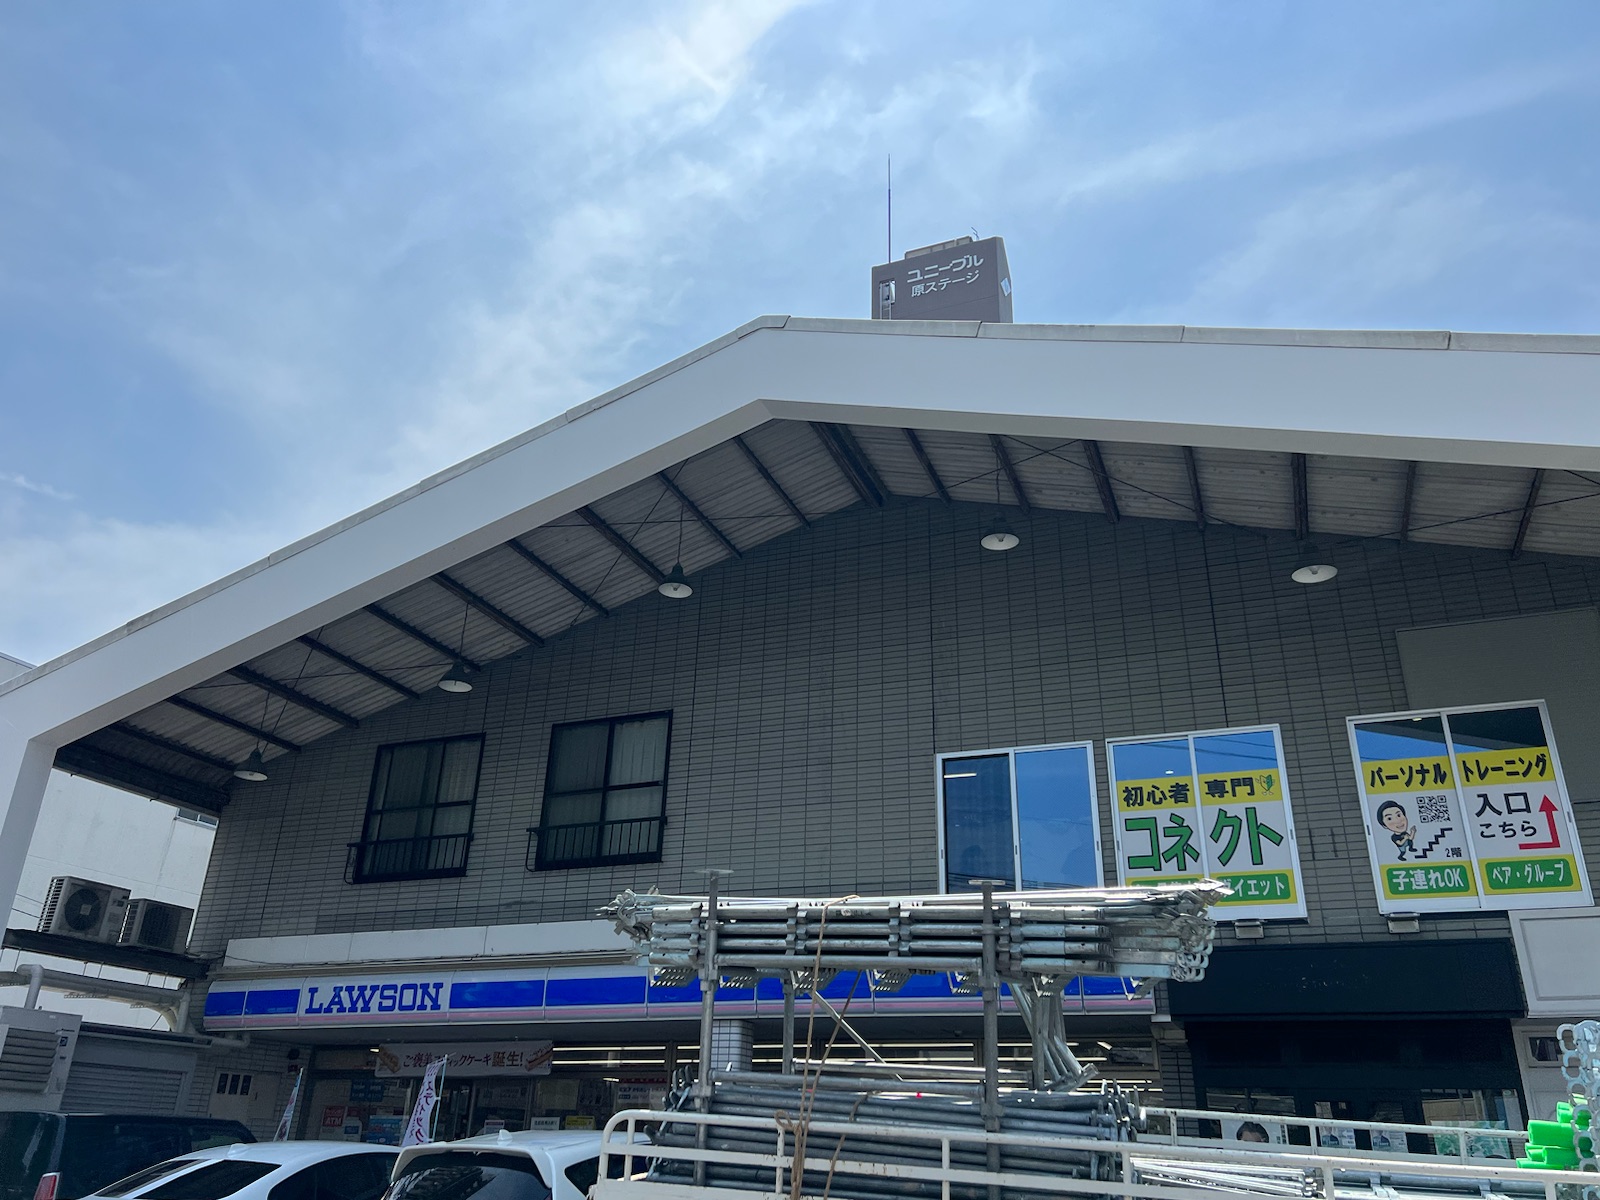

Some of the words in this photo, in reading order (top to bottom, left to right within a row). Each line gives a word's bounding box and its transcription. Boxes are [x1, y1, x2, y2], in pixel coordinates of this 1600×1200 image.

[907, 254, 984, 283] ユニーブル
[911, 270, 980, 297] 原ステージ
[1369, 763, 1447, 788] パーソナル
[1461, 753, 1548, 783] トレーニング
[1122, 782, 1190, 808] 初心者
[1204, 777, 1256, 799] 専門
[1474, 792, 1532, 818] 入口
[1124, 806, 1284, 872] コネクト
[1479, 820, 1538, 839] こちら
[1445, 847, 1462, 858] 2階
[1392, 867, 1464, 891] 子連れOK
[1492, 860, 1565, 884] ペア・グループ
[305, 982, 444, 1014] LAWSON
